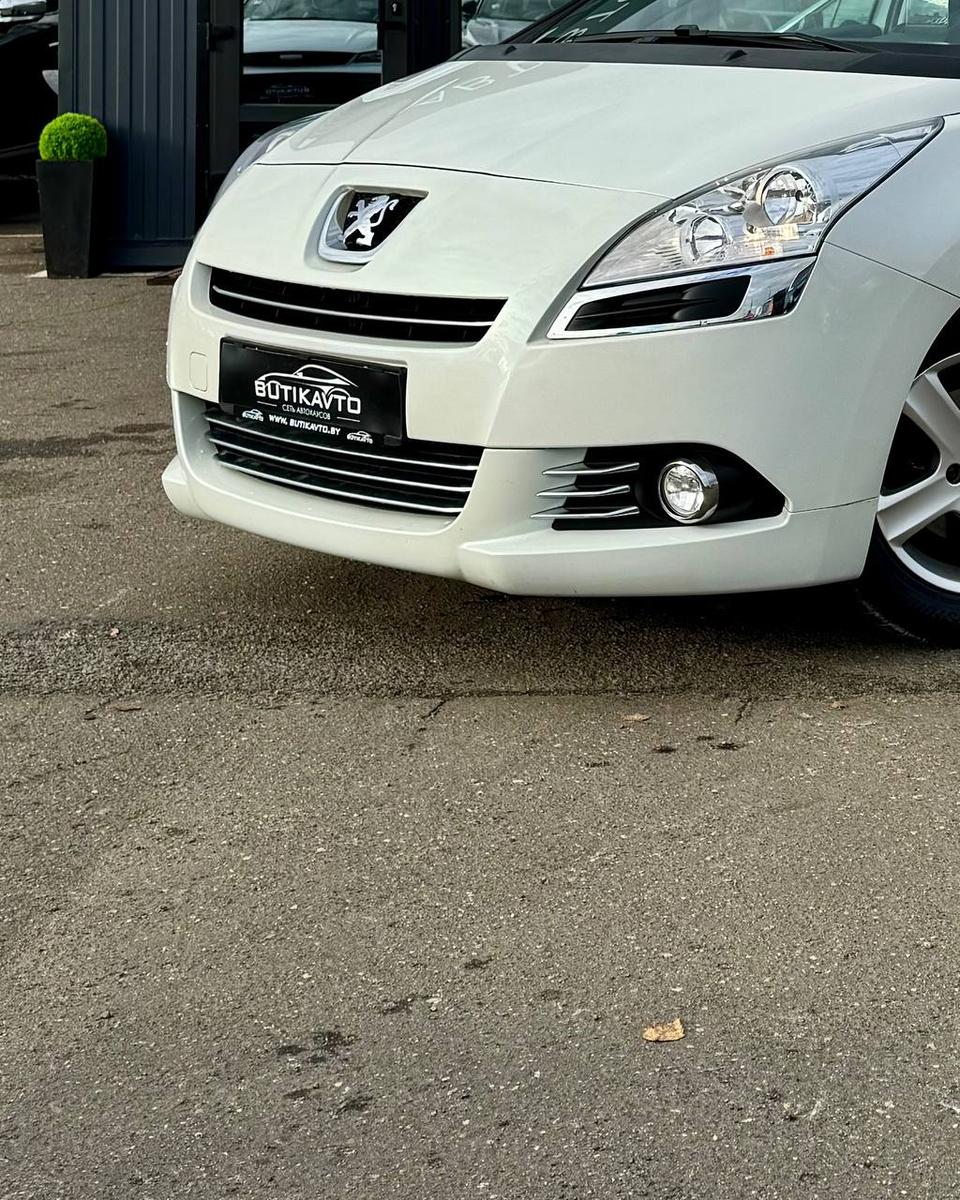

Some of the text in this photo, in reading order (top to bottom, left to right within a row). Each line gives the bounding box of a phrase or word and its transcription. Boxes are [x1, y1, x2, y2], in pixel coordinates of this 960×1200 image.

[254, 379, 361, 415] BUTIKAVTO
[281, 403, 296, 413] СЕТЬ
[289, 418, 341, 436] BUTIKAVTO.BY
